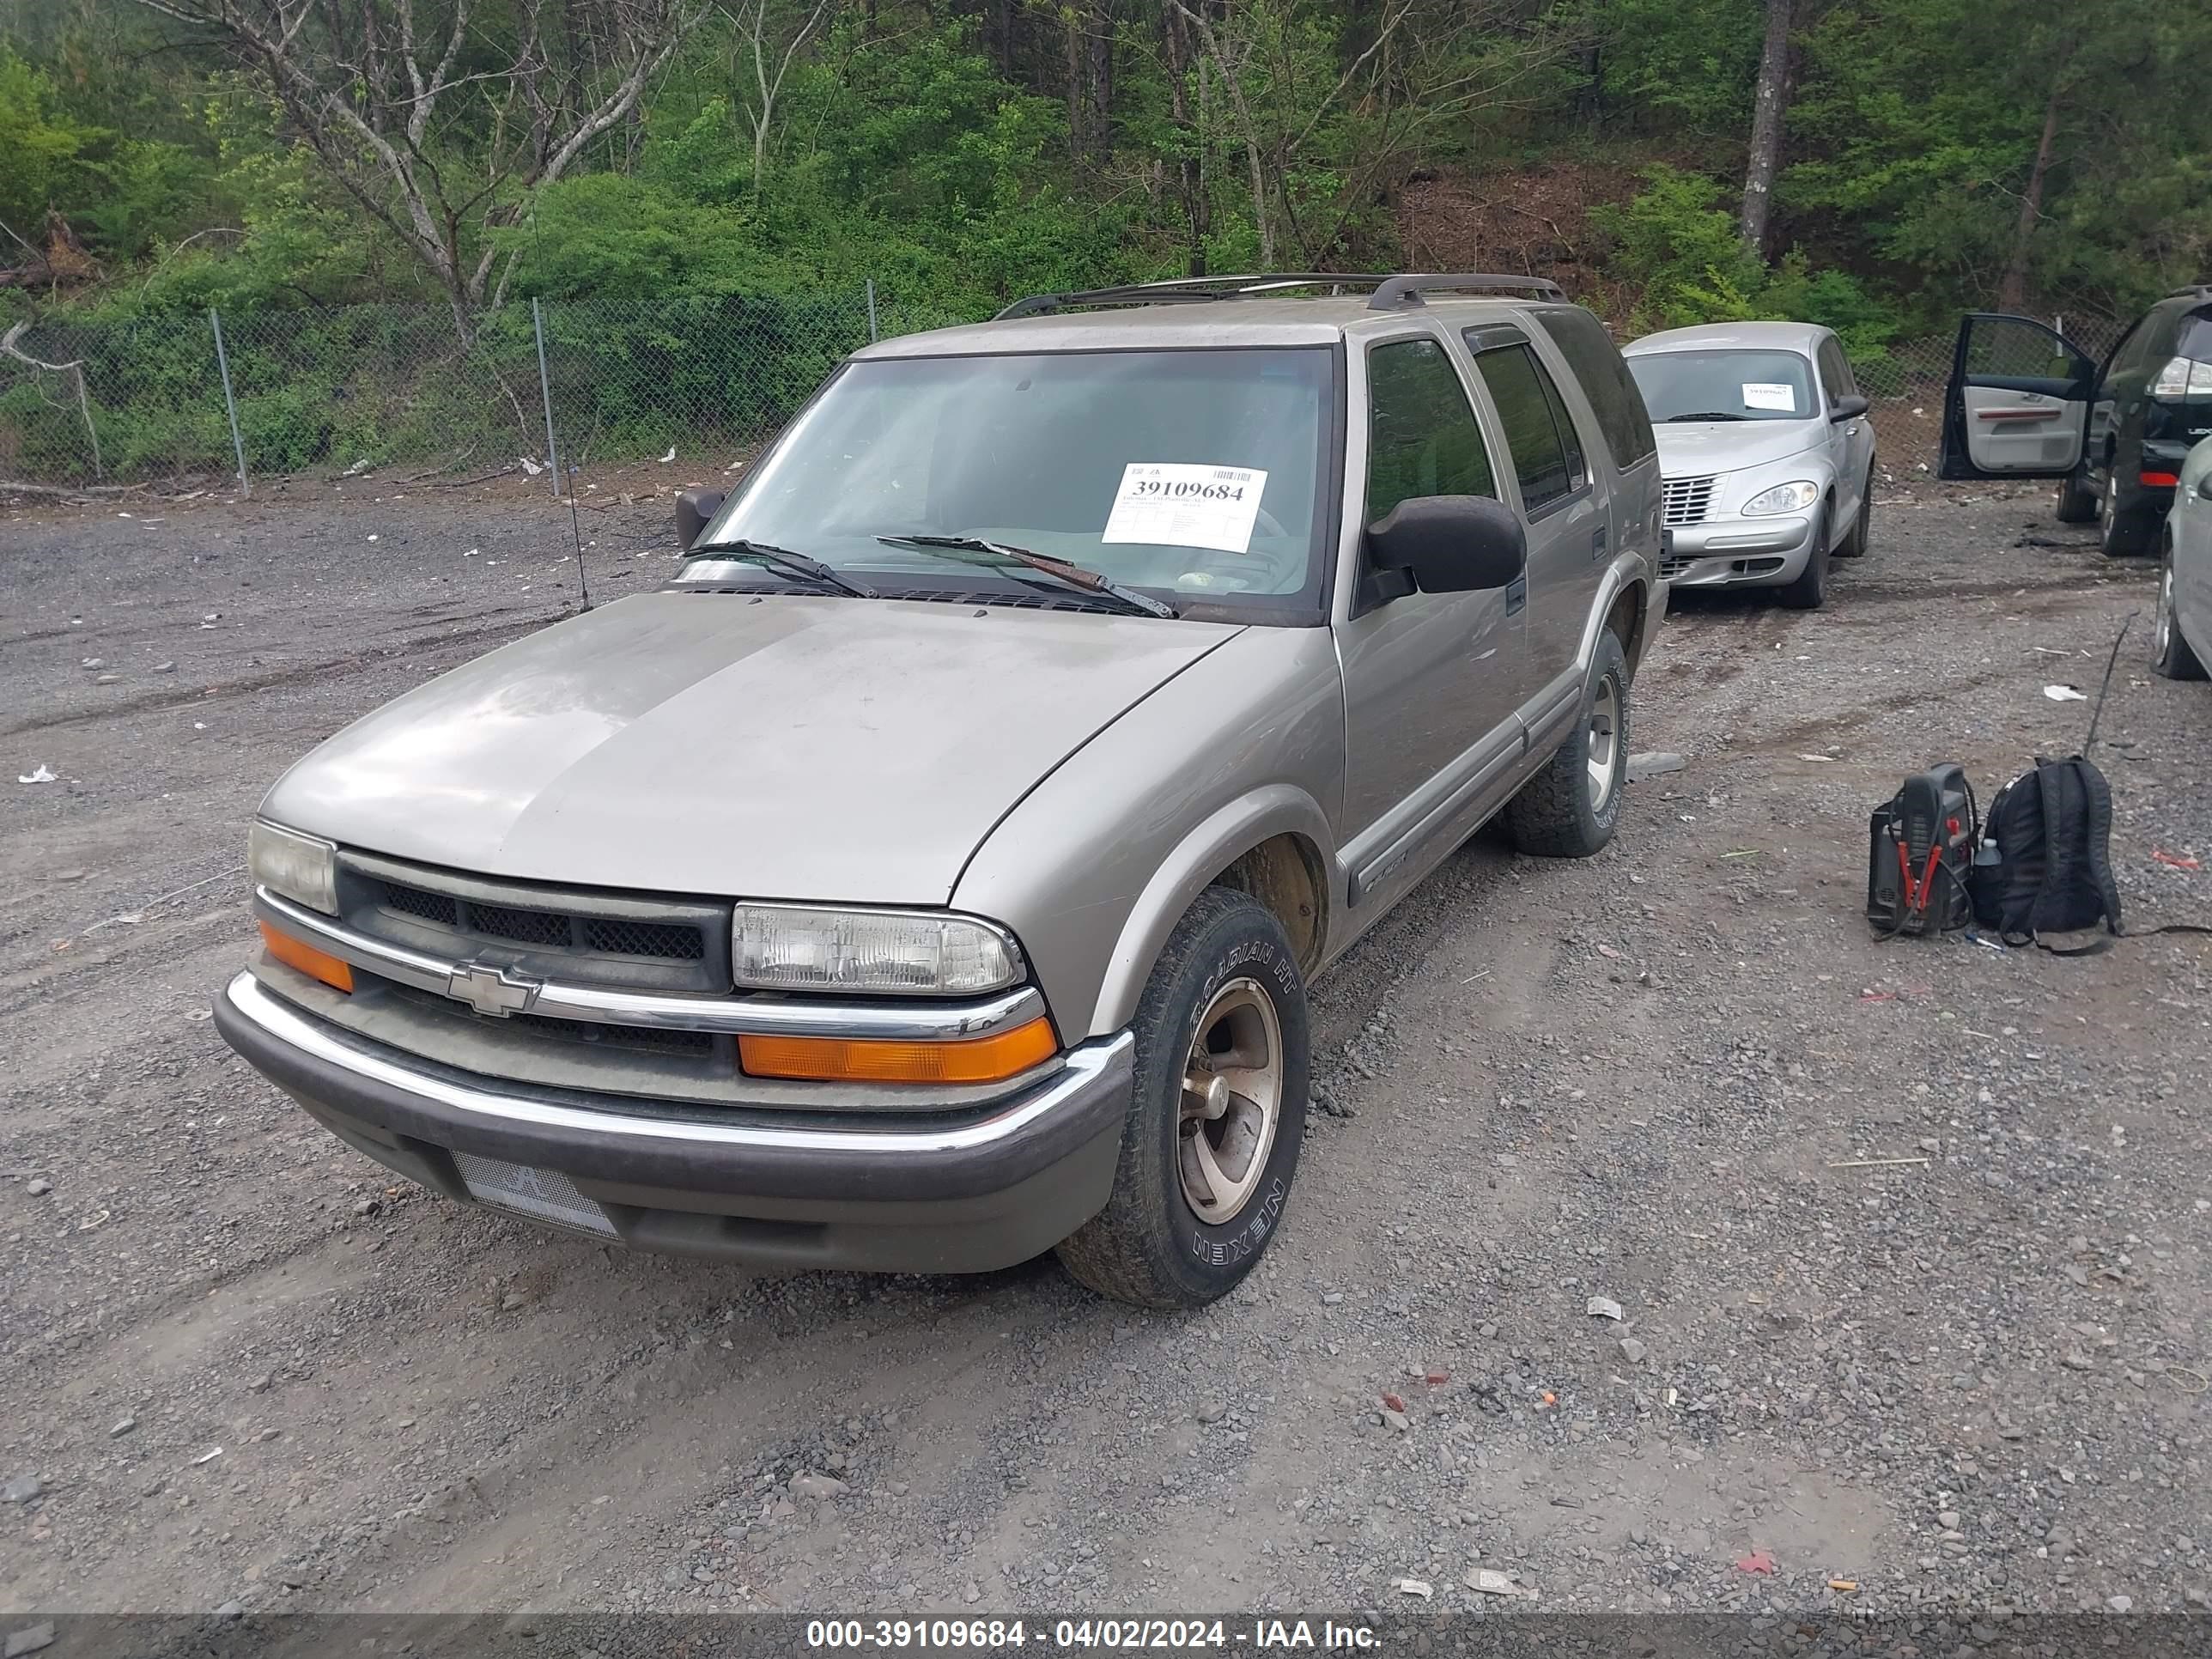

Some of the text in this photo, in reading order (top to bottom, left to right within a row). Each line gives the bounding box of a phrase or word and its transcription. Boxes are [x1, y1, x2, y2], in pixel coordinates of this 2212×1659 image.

[1132, 481, 1244, 501] 39109684
[1273, 958, 1297, 995] HT
[1192, 1178, 1285, 1266] NEXEN
